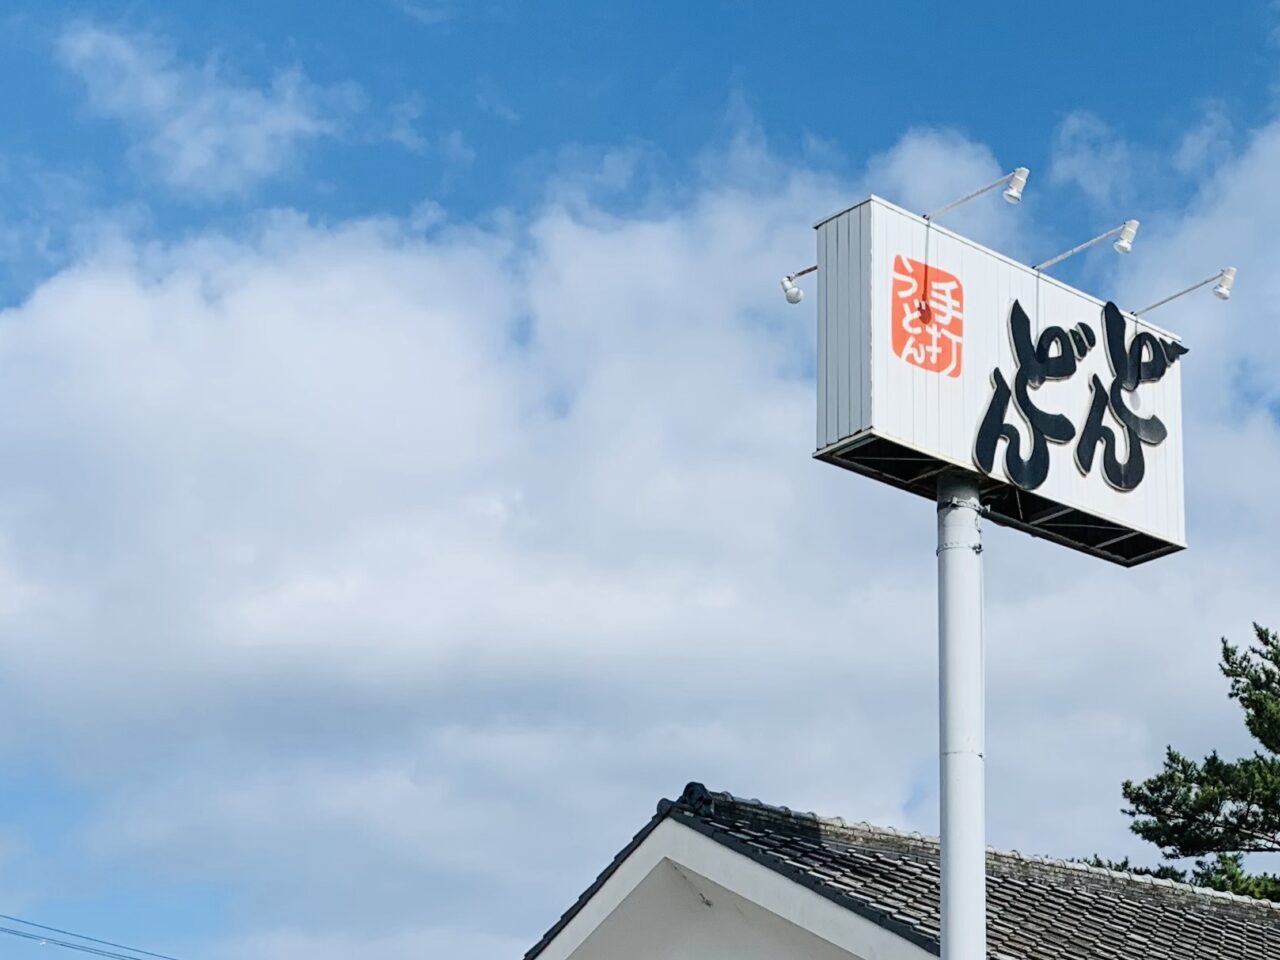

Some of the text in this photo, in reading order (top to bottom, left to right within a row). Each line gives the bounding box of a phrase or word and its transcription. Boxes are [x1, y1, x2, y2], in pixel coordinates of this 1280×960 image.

[892, 255, 927, 364] うどん
[926, 281, 962, 375] 手打
